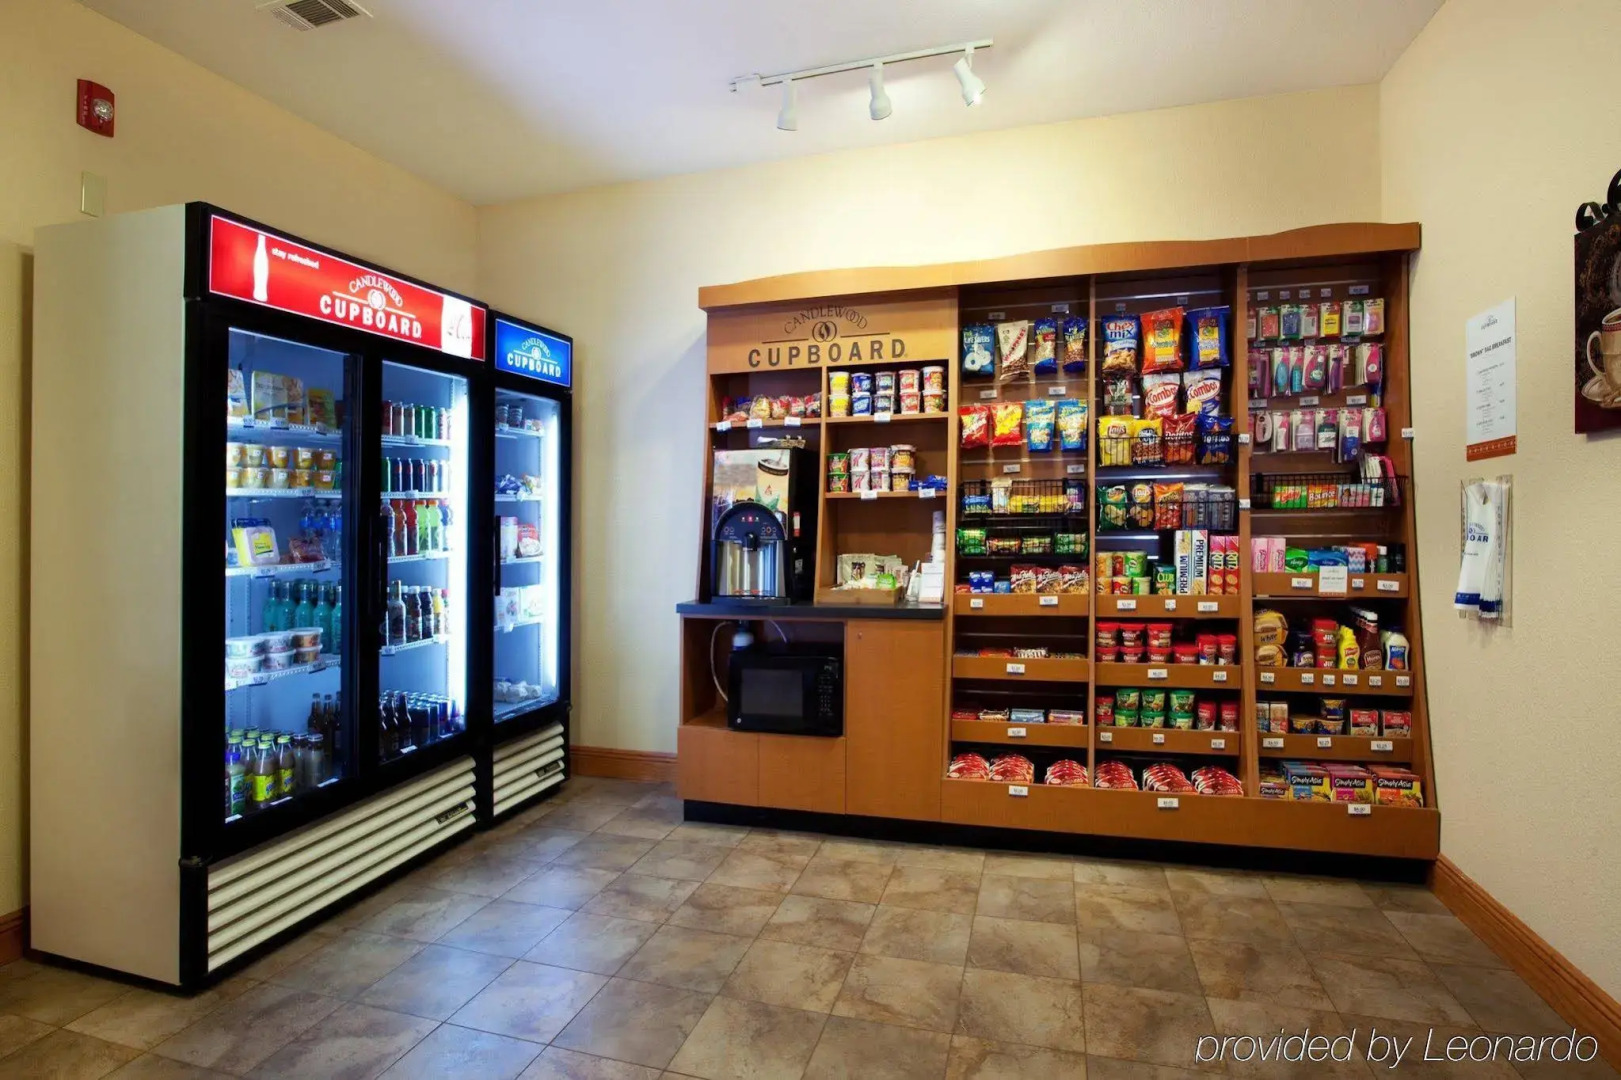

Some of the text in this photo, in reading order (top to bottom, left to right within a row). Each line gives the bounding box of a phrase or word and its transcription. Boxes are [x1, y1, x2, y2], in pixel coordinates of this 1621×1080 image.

[349, 275, 403, 307] CANDLEWOOD
[319, 294, 422, 339] CUPBOARD
[784, 304, 868, 334] CANDLEWOOD
[1106, 321, 1134, 331] Chex
[521, 337, 551, 357] CANDLEWOOD
[748, 338, 906, 368] CUPBOARD
[506, 351, 562, 378] CUPBOARD
[1309, 490, 1335, 502] Bounce
[1195, 539, 1204, 578] PREMIUM
[1180, 555, 1188, 594] PREMIUM
